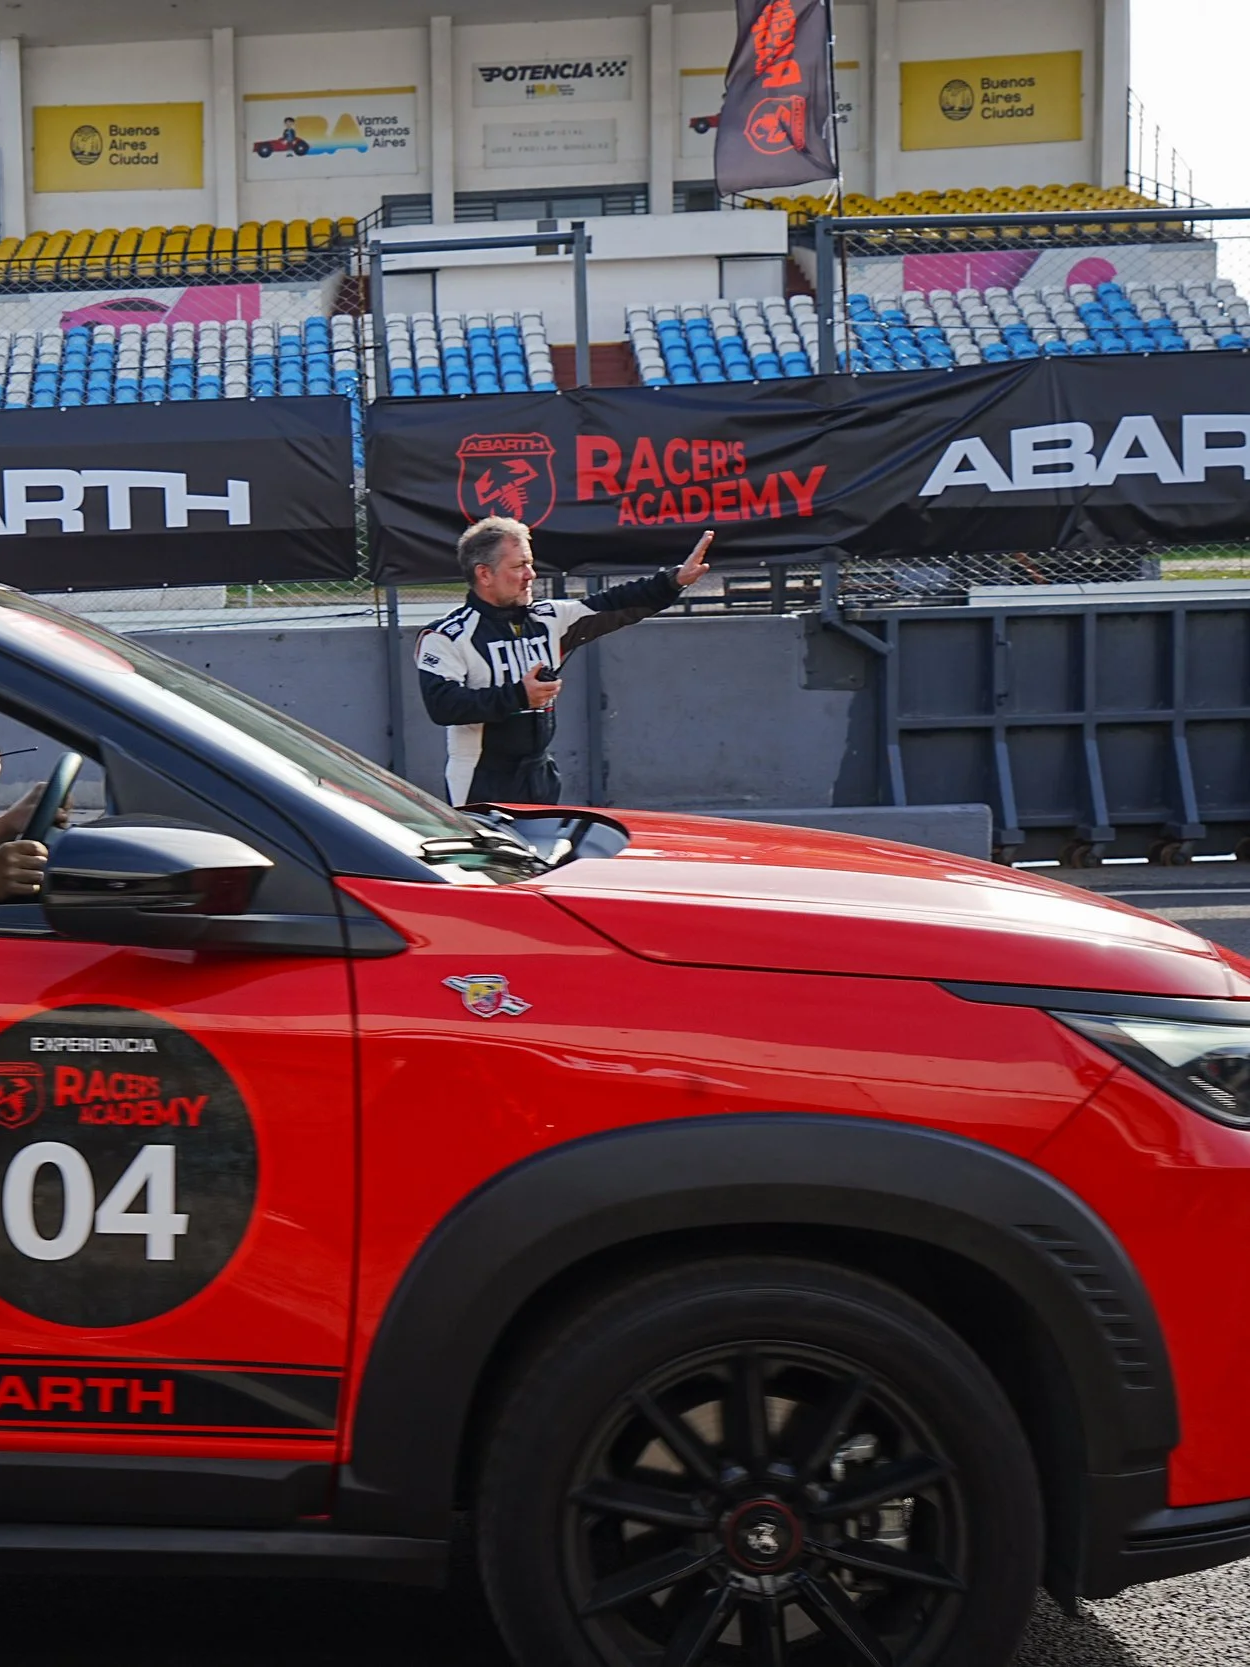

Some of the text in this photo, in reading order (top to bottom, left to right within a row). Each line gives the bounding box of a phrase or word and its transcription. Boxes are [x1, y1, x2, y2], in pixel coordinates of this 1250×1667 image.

[478, 62, 594, 82] POTENCIA
[980, 77, 1036, 90] Buenos
[980, 92, 1022, 105] Aires
[980, 104, 1035, 119] Ciudad
[356, 115, 398, 126] Vamos
[109, 124, 160, 137] Buenos
[364, 126, 410, 137] Buenos
[108, 139, 147, 152] Aires
[372, 136, 406, 148] Aires
[108, 153, 159, 166] Ciudad
[463, 439, 545, 452] ABARTH
[576, 435, 747, 501] RACER'S
[617, 465, 828, 527] ACADEMY
[487, 635, 552, 688] FIAT
[30, 1037, 159, 1053] EXPERIENCIA
[78, 1095, 210, 1126] ACADEMY
[2, 1141, 190, 1261] 04
